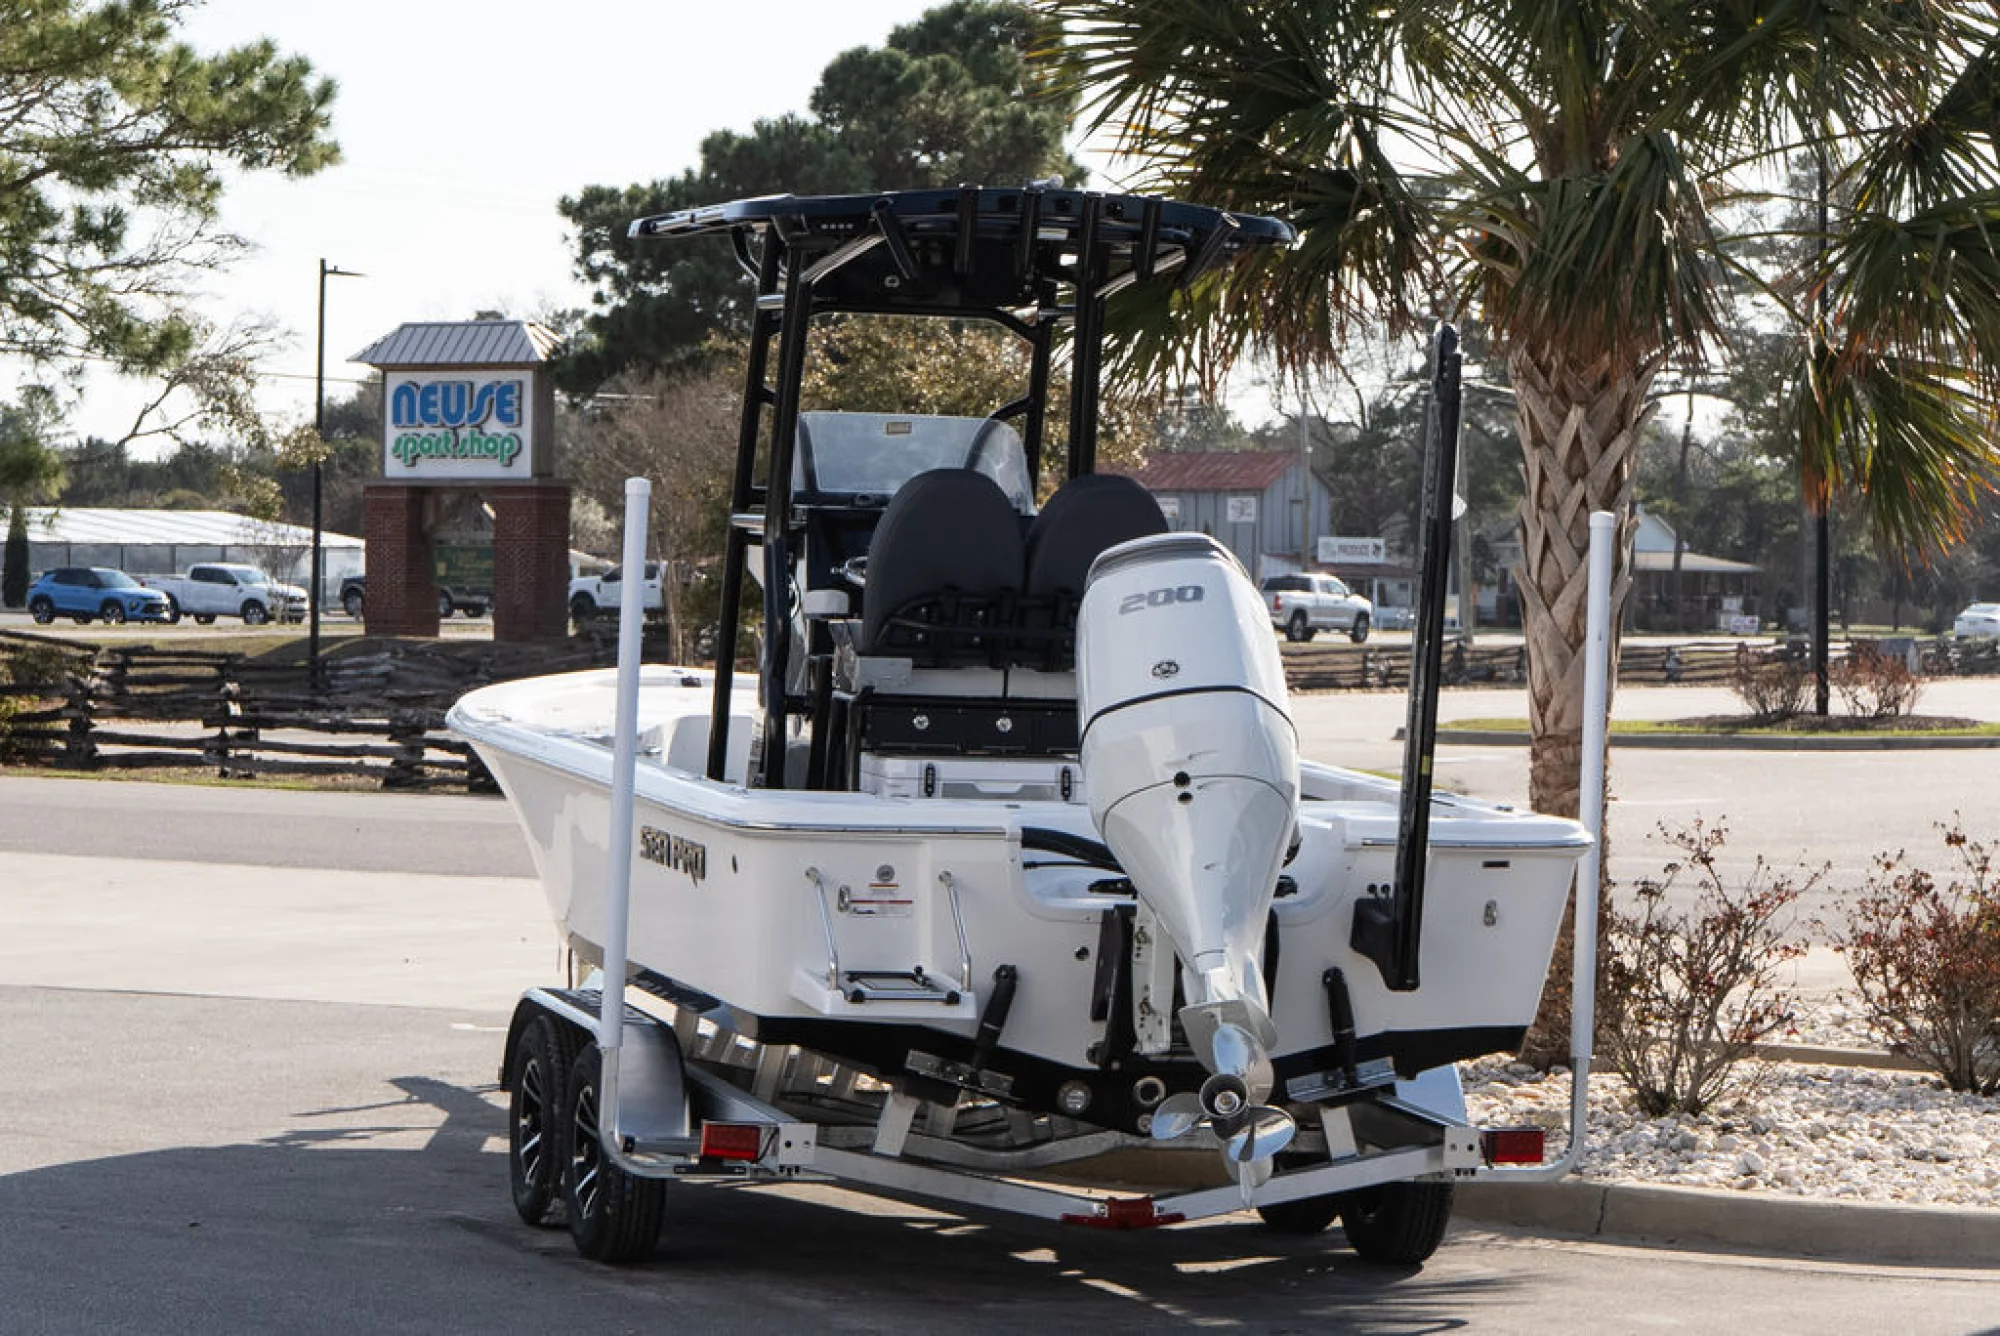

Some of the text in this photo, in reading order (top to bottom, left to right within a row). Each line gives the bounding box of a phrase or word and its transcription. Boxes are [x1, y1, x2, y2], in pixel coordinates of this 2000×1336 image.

[392, 382, 519, 427] NEUSE
[391, 431, 518, 465] sport shop
[1118, 585, 1204, 616] 200
[640, 825, 706, 888] SEA PRO
